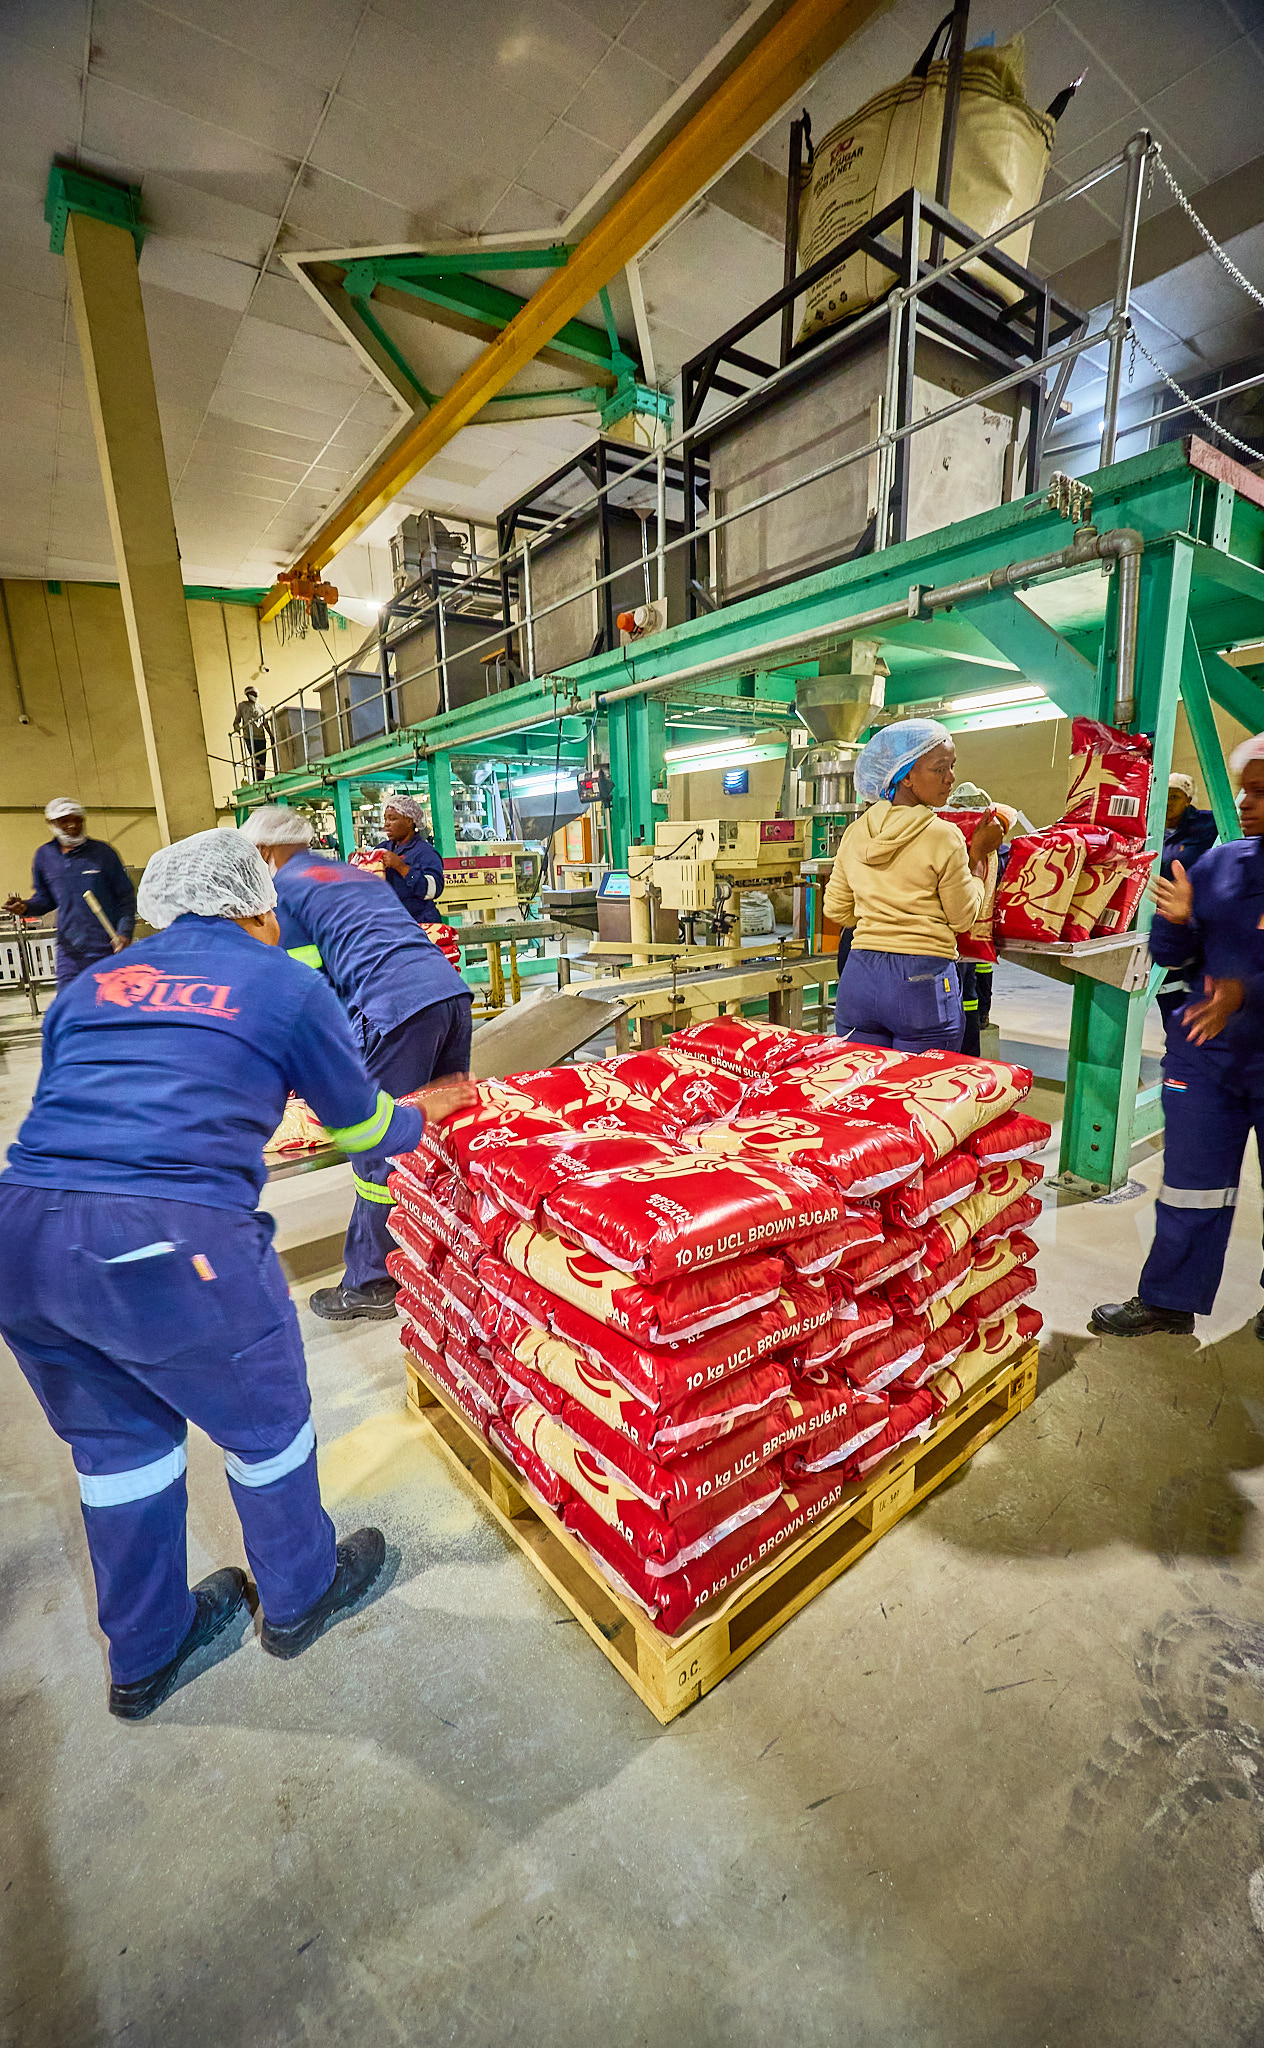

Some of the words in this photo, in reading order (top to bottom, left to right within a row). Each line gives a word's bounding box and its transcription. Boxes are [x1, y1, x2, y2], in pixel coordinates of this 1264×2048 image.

[149, 982, 242, 1014] UCL
[710, 1055, 742, 1074] BROWN
[408, 1201, 421, 1219] UCL
[646, 1199, 686, 1225] SUGAR
[646, 1209, 657, 1219] 10
[654, 1215, 668, 1227] kg
[650, 1193, 694, 1222] BROWN
[675, 1248, 693, 1268] 10
[696, 1242, 714, 1260] kg
[717, 1232, 745, 1251] UCL
[748, 1216, 796, 1242] BROWN
[798, 1207, 839, 1228] SUGAR
[547, 1267, 587, 1298] BROWN
[589, 1291, 630, 1330] SUGAR
[686, 1372, 703, 1391] 10
[707, 1363, 725, 1381] kg
[727, 1346, 755, 1369] UCL
[757, 1322, 800, 1355] BROWN
[802, 1307, 834, 1331] SUGA
[424, 1359, 436, 1378] UCL
[436, 1372, 460, 1405] BROWN
[459, 1399, 483, 1432] SUGAR
[600, 1402, 639, 1445] SUGAR
[695, 1480, 712, 1500] 10
[715, 1470, 731, 1488] kg
[734, 1450, 760, 1475] UCL
[762, 1422, 806, 1457] BROWN
[808, 1403, 848, 1431] SUGAR
[556, 1458, 593, 1500] BROWN
[596, 1496, 634, 1545] SUGAR
[694, 1589, 709, 1608] 10
[712, 1576, 728, 1594] kg
[730, 1553, 756, 1579] UCL
[758, 1513, 804, 1557] BROWN
[806, 1485, 843, 1521] SUGAR
